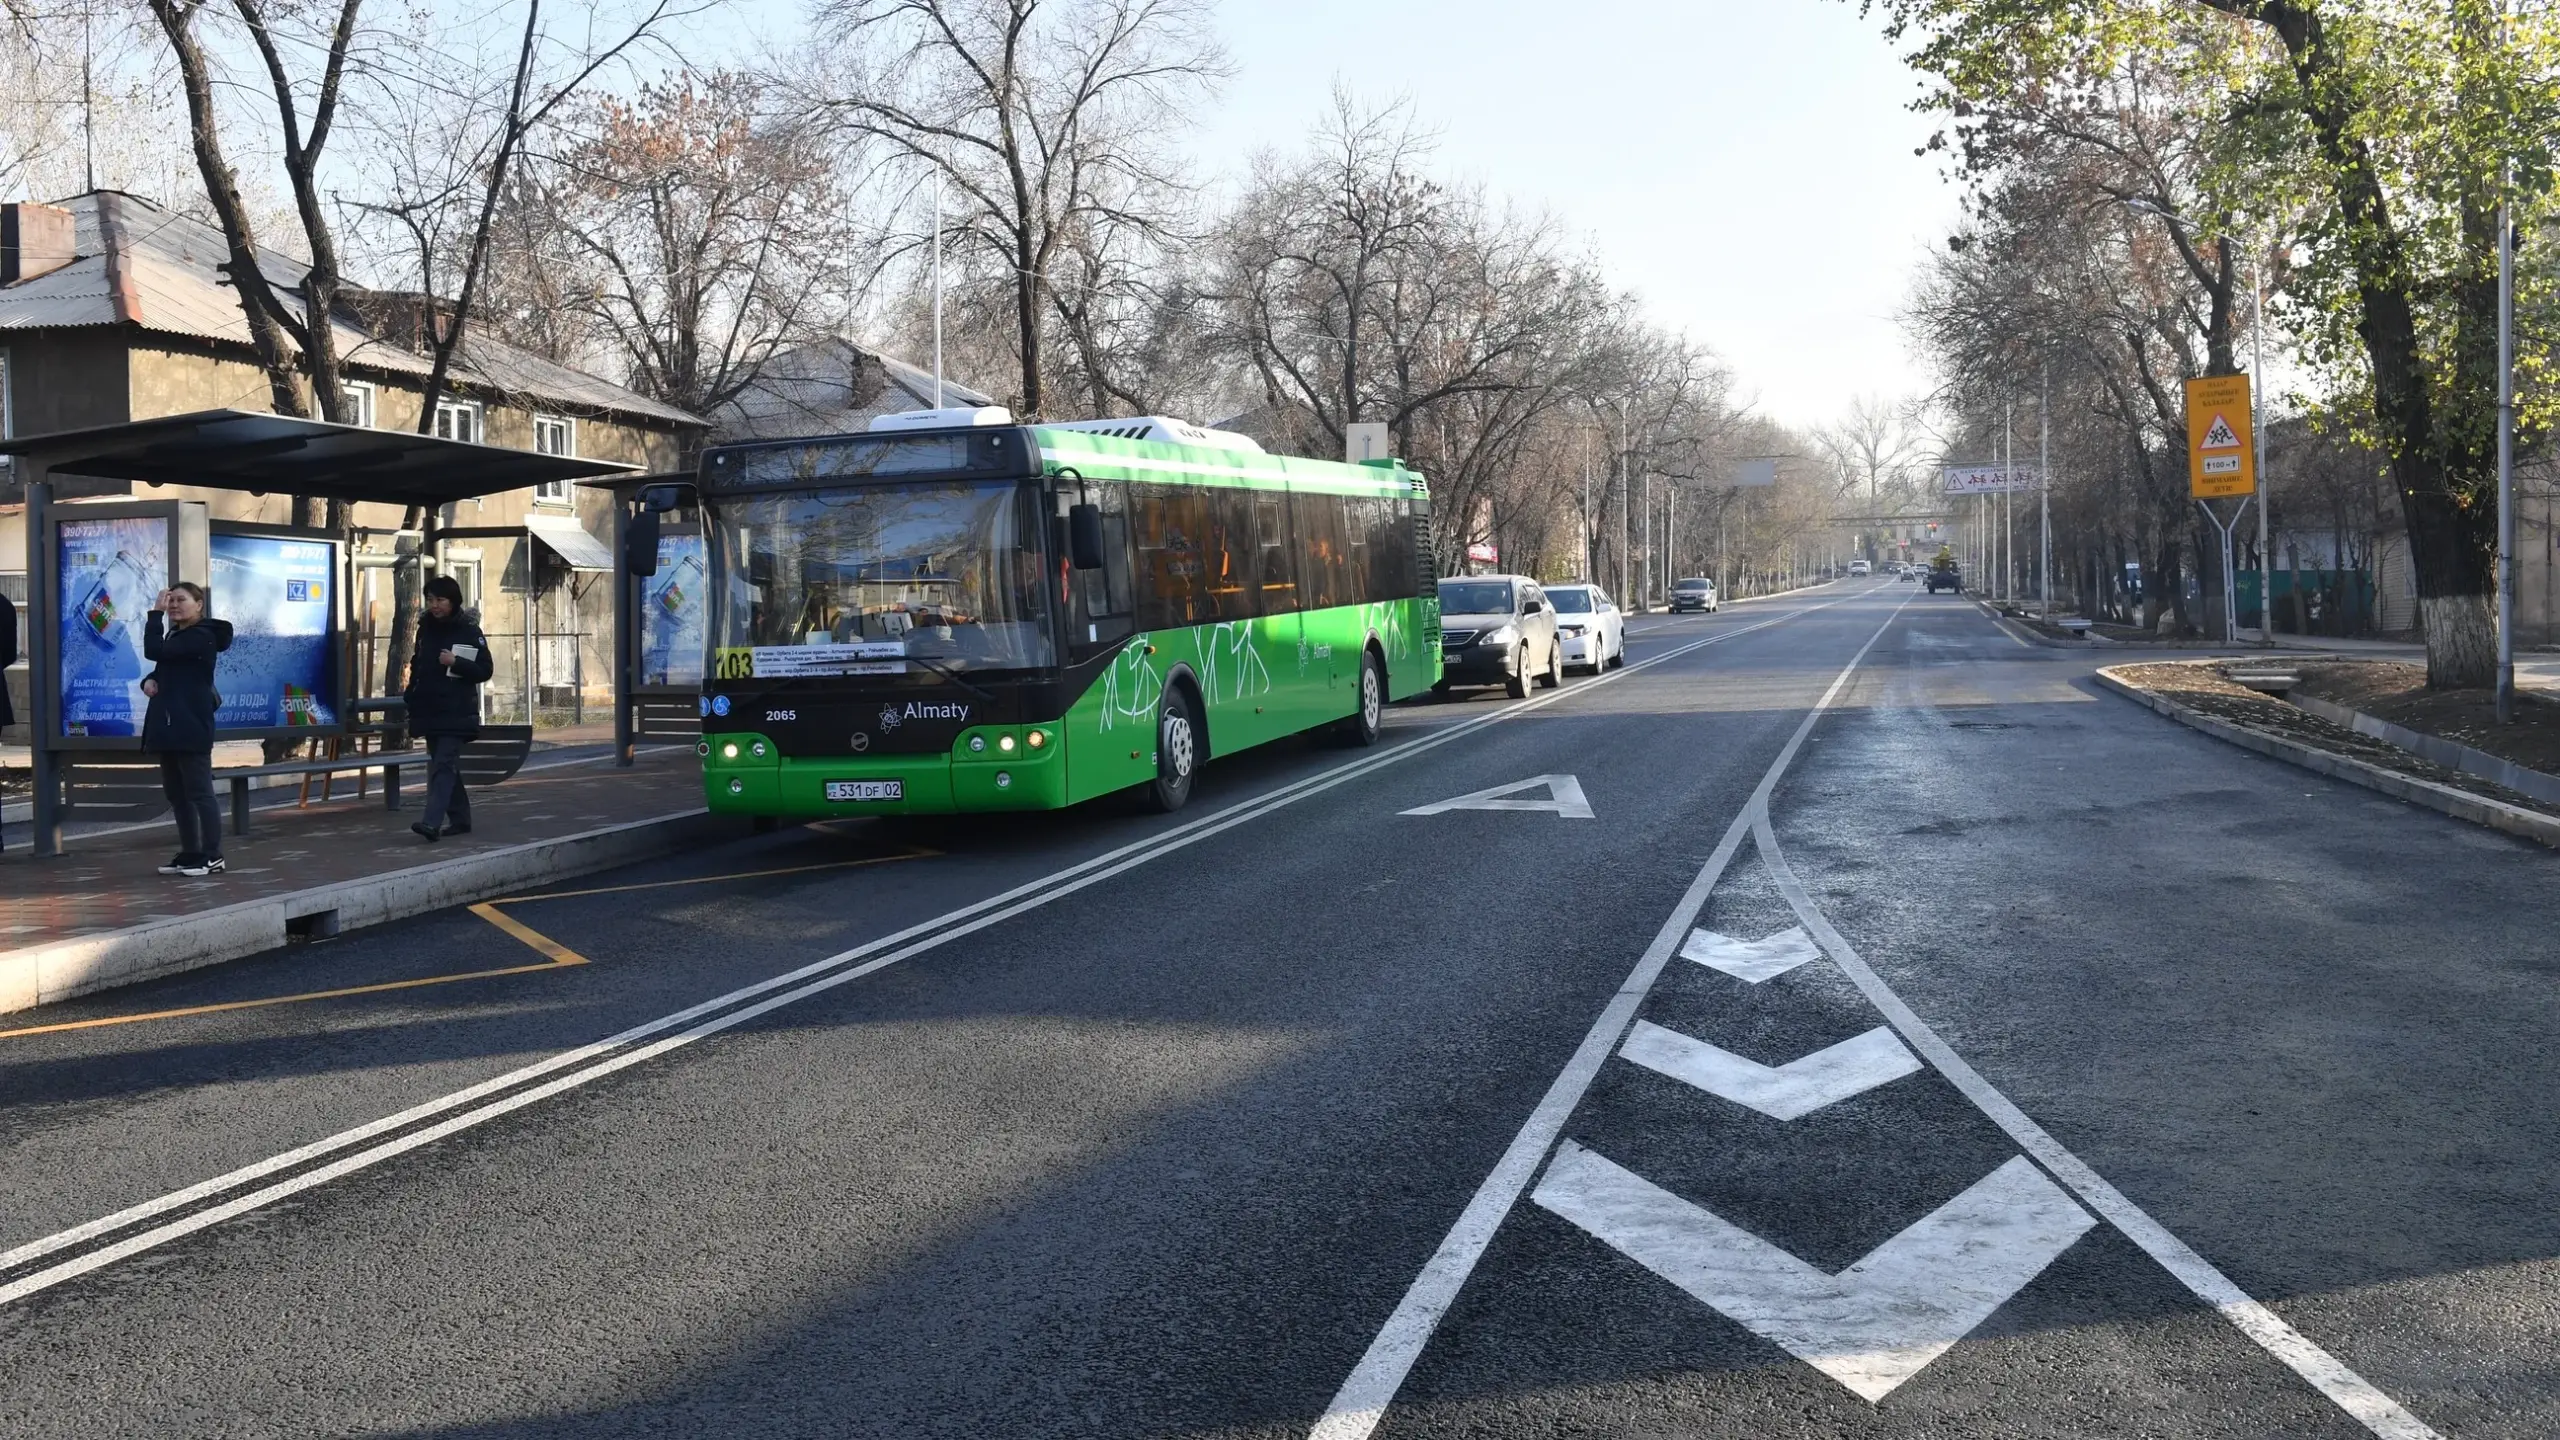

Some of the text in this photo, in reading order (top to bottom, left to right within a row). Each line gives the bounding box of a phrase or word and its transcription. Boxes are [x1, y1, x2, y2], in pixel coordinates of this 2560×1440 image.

[289, 583, 305, 598] KZ
[716, 652, 754, 679] 103
[239, 693, 269, 708] ВОДЫ
[248, 710, 269, 723] ОФИС
[766, 710, 796, 721] 2065
[904, 701, 969, 721] Almaty
[839, 783, 862, 797] 531
[865, 785, 880, 797] DF
[885, 782, 900, 796] 02
